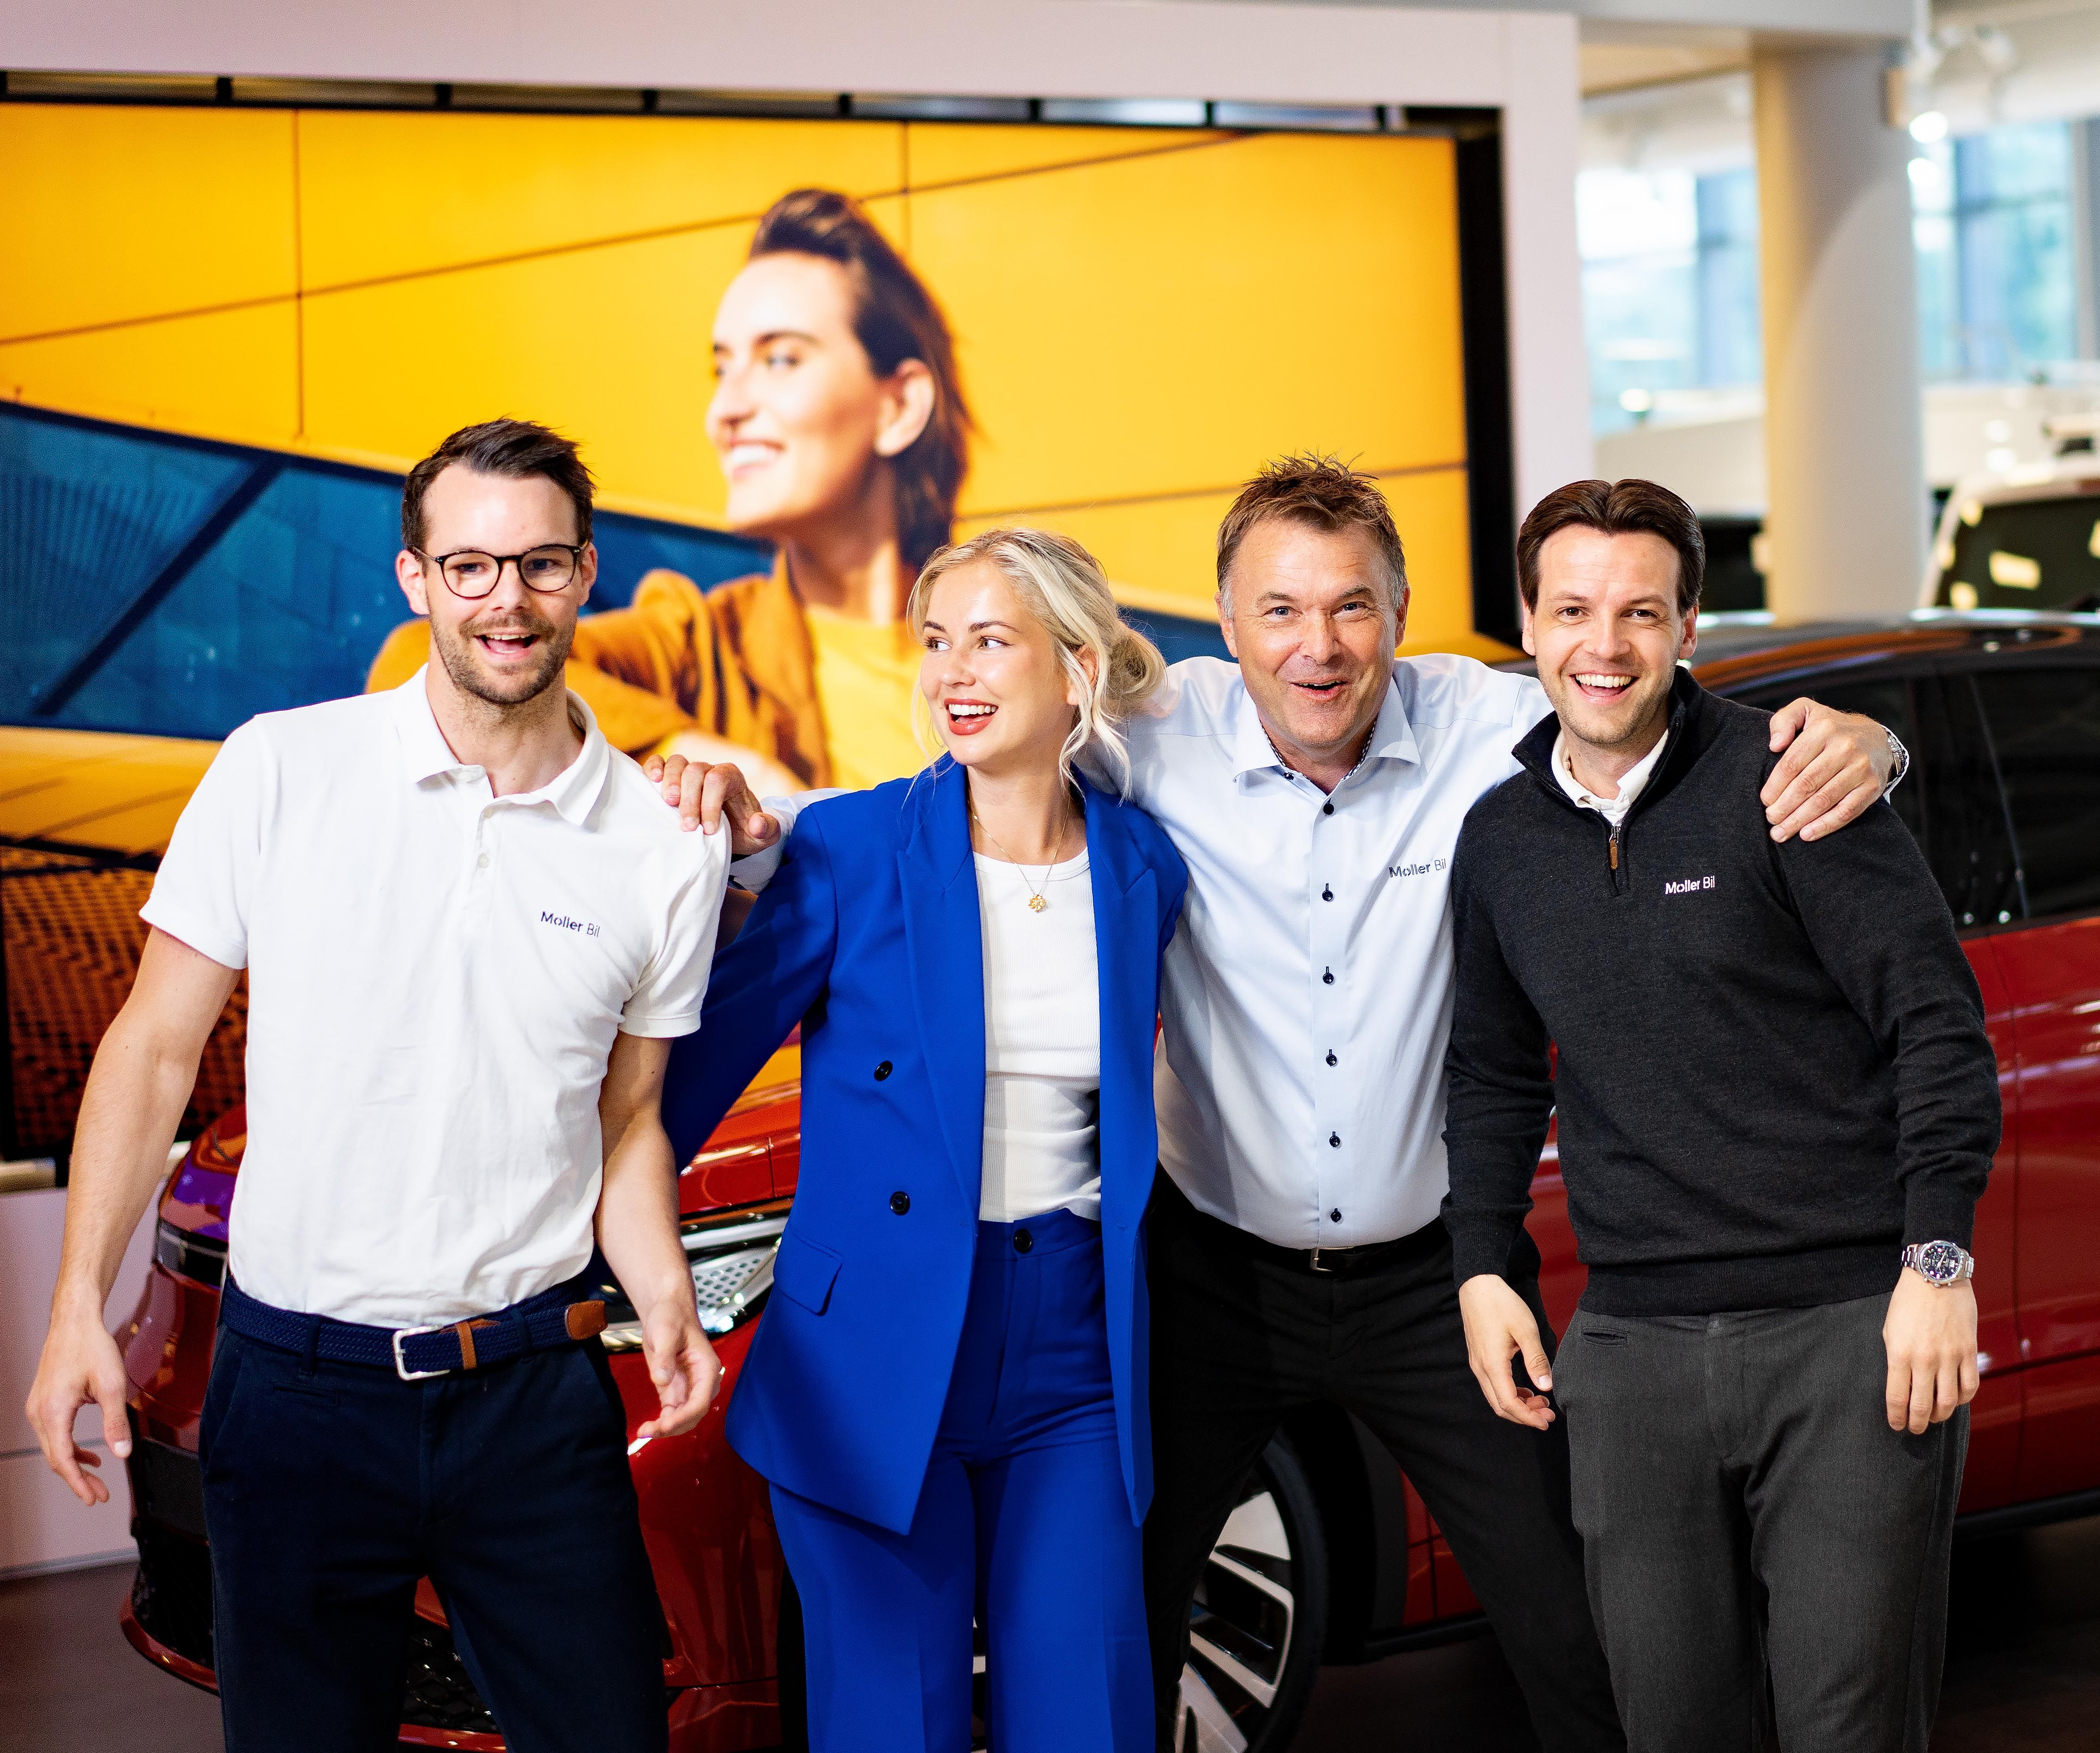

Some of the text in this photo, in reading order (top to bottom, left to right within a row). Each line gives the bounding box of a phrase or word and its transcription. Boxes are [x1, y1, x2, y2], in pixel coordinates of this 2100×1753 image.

[1434, 858, 1446, 871] Bil
[1703, 875, 1715, 889] Bil
[586, 923, 600, 937] Bil
